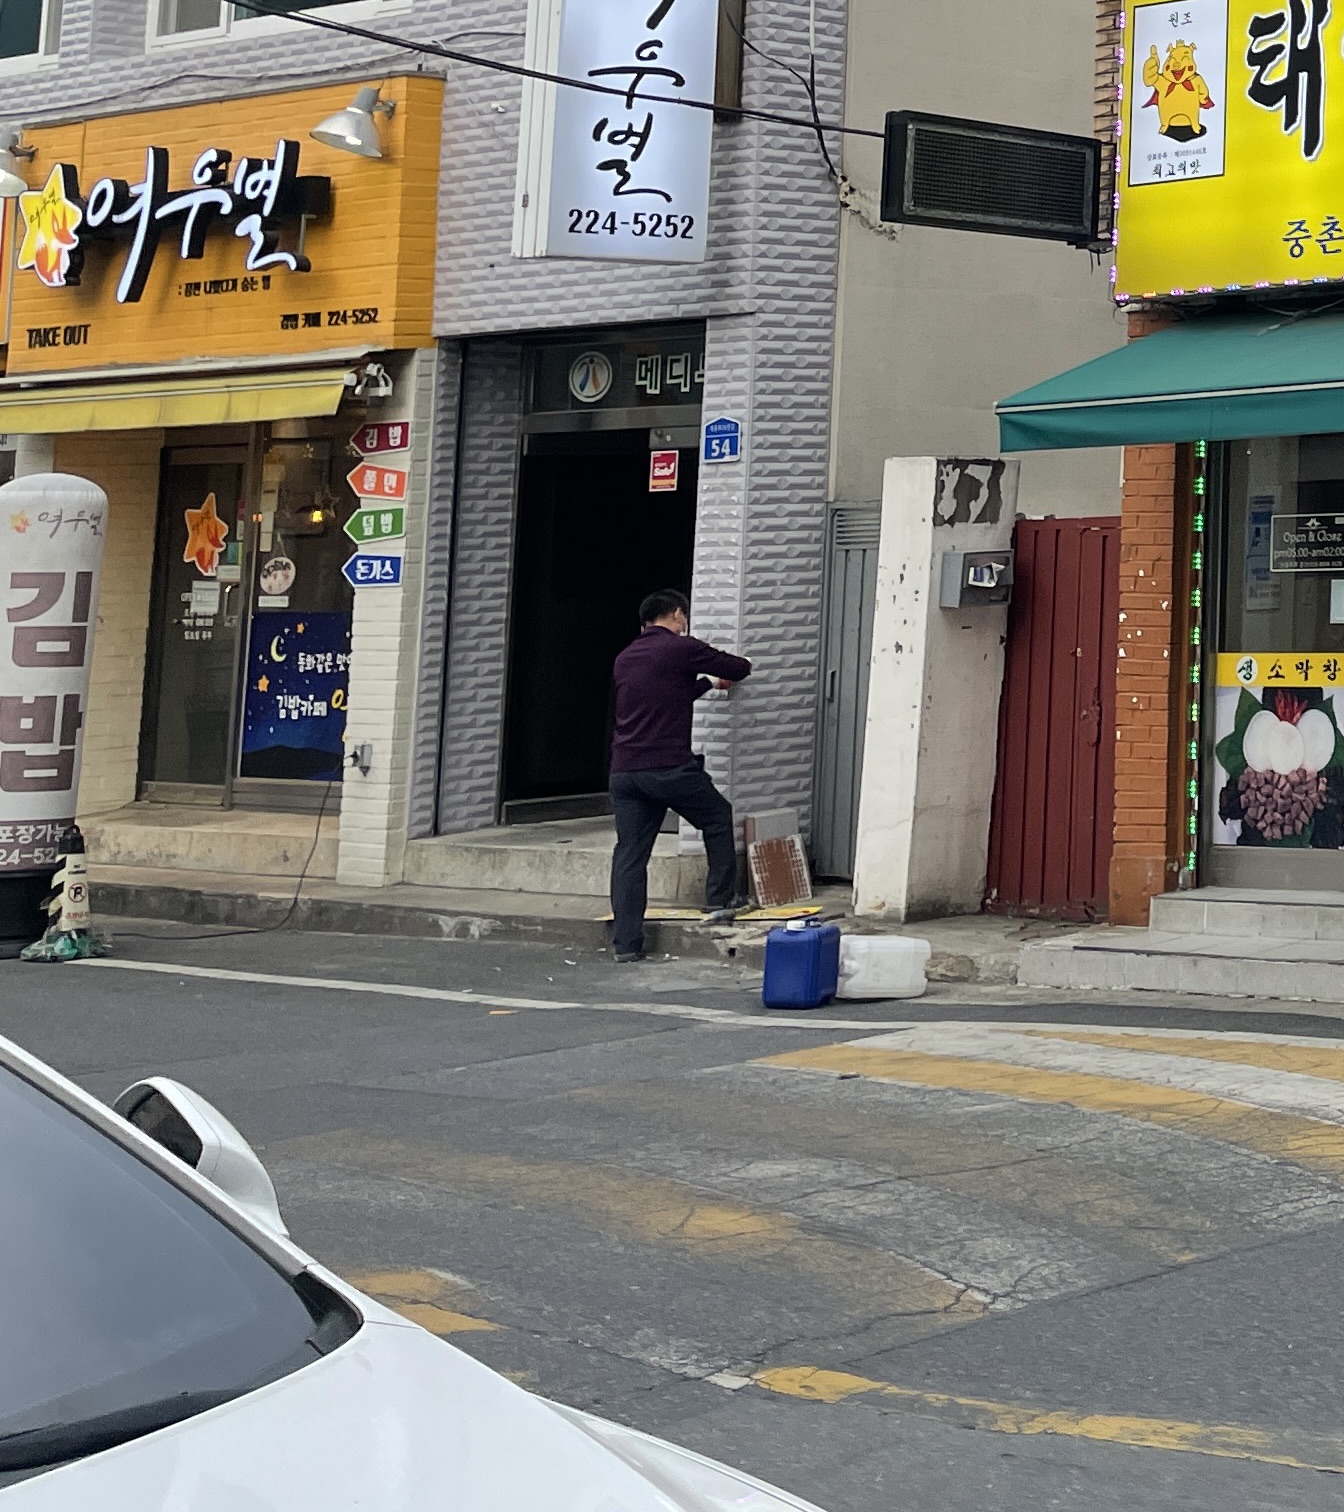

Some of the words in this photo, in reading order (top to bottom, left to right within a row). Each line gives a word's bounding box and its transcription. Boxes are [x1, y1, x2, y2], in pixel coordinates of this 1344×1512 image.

[1167, 10, 1193, 28] 원조
[567, 207, 695, 241] 224-5252
[327, 307, 379, 327] 224-5252
[26, 326, 61, 350] TAKE
[63, 324, 91, 347] OUT
[710, 438, 731, 458] 54
[355, 559, 394, 581] 돈가스
[0, 571, 93, 793] 김밥
[1268, 658, 1342, 683] 소막창
